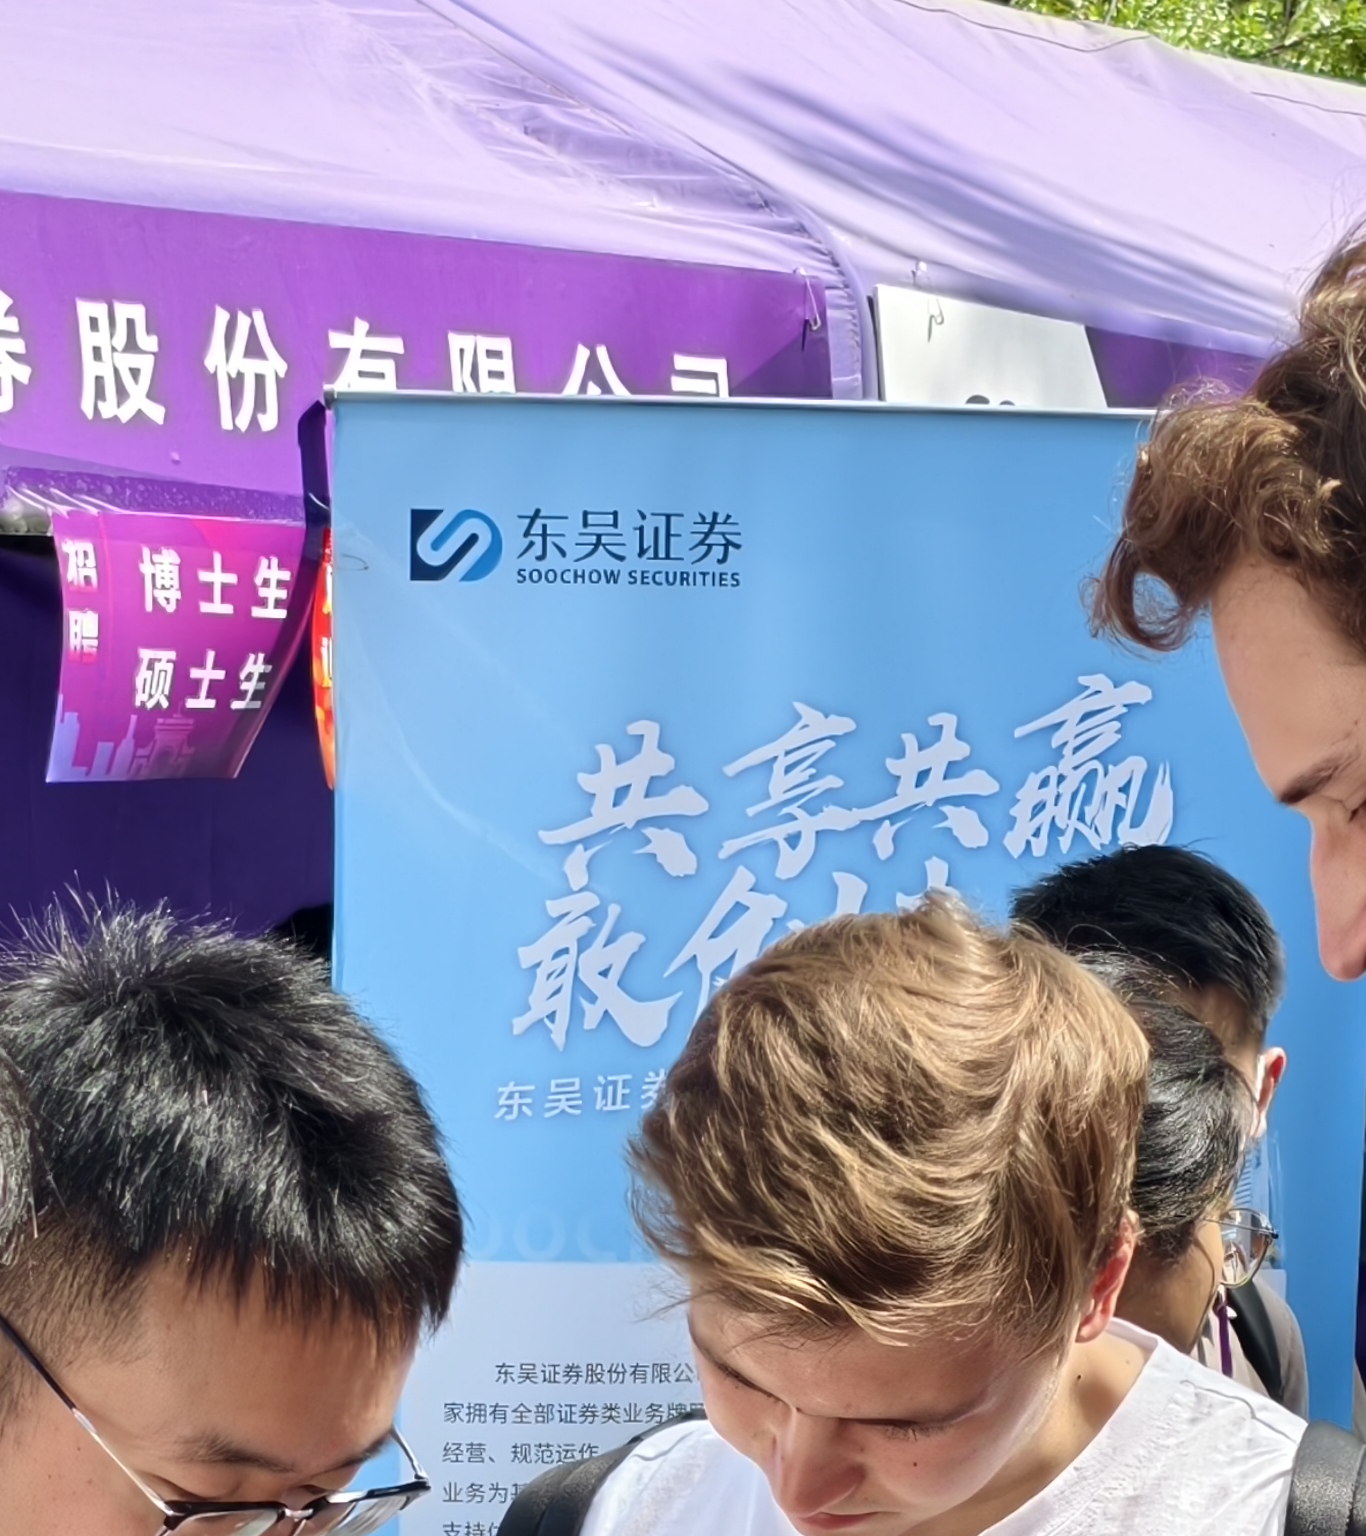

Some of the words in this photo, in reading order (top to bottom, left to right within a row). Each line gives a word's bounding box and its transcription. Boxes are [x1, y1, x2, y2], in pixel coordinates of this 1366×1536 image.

[516, 507, 742, 565] 东吴证券
[61, 538, 99, 655] 招聘
[139, 545, 292, 619] 博士生
[516, 568, 621, 585] SOOCHOW
[627, 569, 742, 588] SECURITIES
[135, 647, 273, 711] 硕士生
[538, 673, 1175, 888] 共享共赢
[495, 1362, 699, 1385] 东吴证券股份有限公
